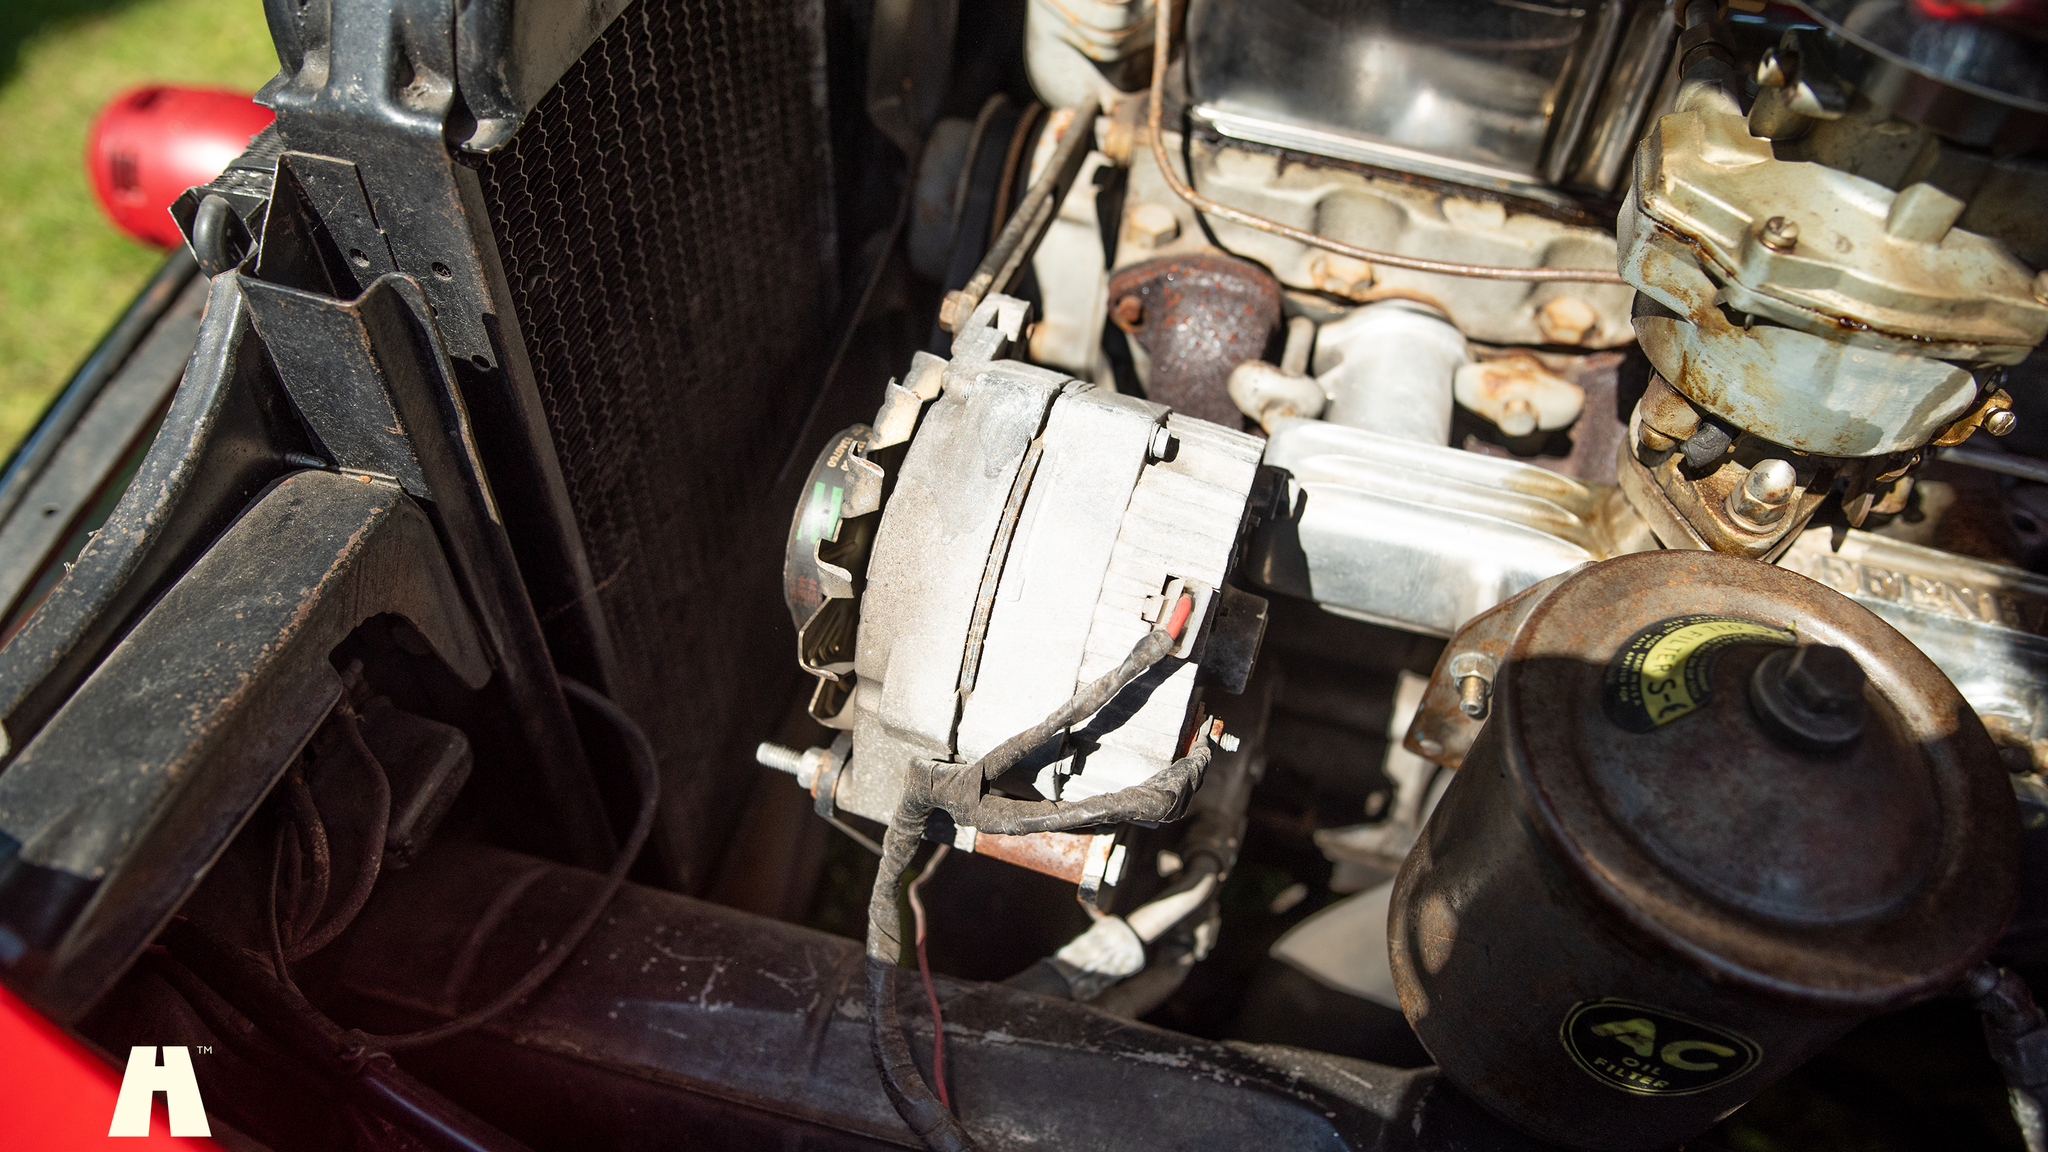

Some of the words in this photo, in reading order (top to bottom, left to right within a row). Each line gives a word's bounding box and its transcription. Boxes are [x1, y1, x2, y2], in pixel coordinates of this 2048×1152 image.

[1701, 624, 1743, 632] OIL
[1651, 629, 1704, 673] FILTER
[1591, 1018, 1736, 1071] AC
[1594, 1057, 1670, 1089] FILTER
[1621, 1056, 1663, 1076] OIL
